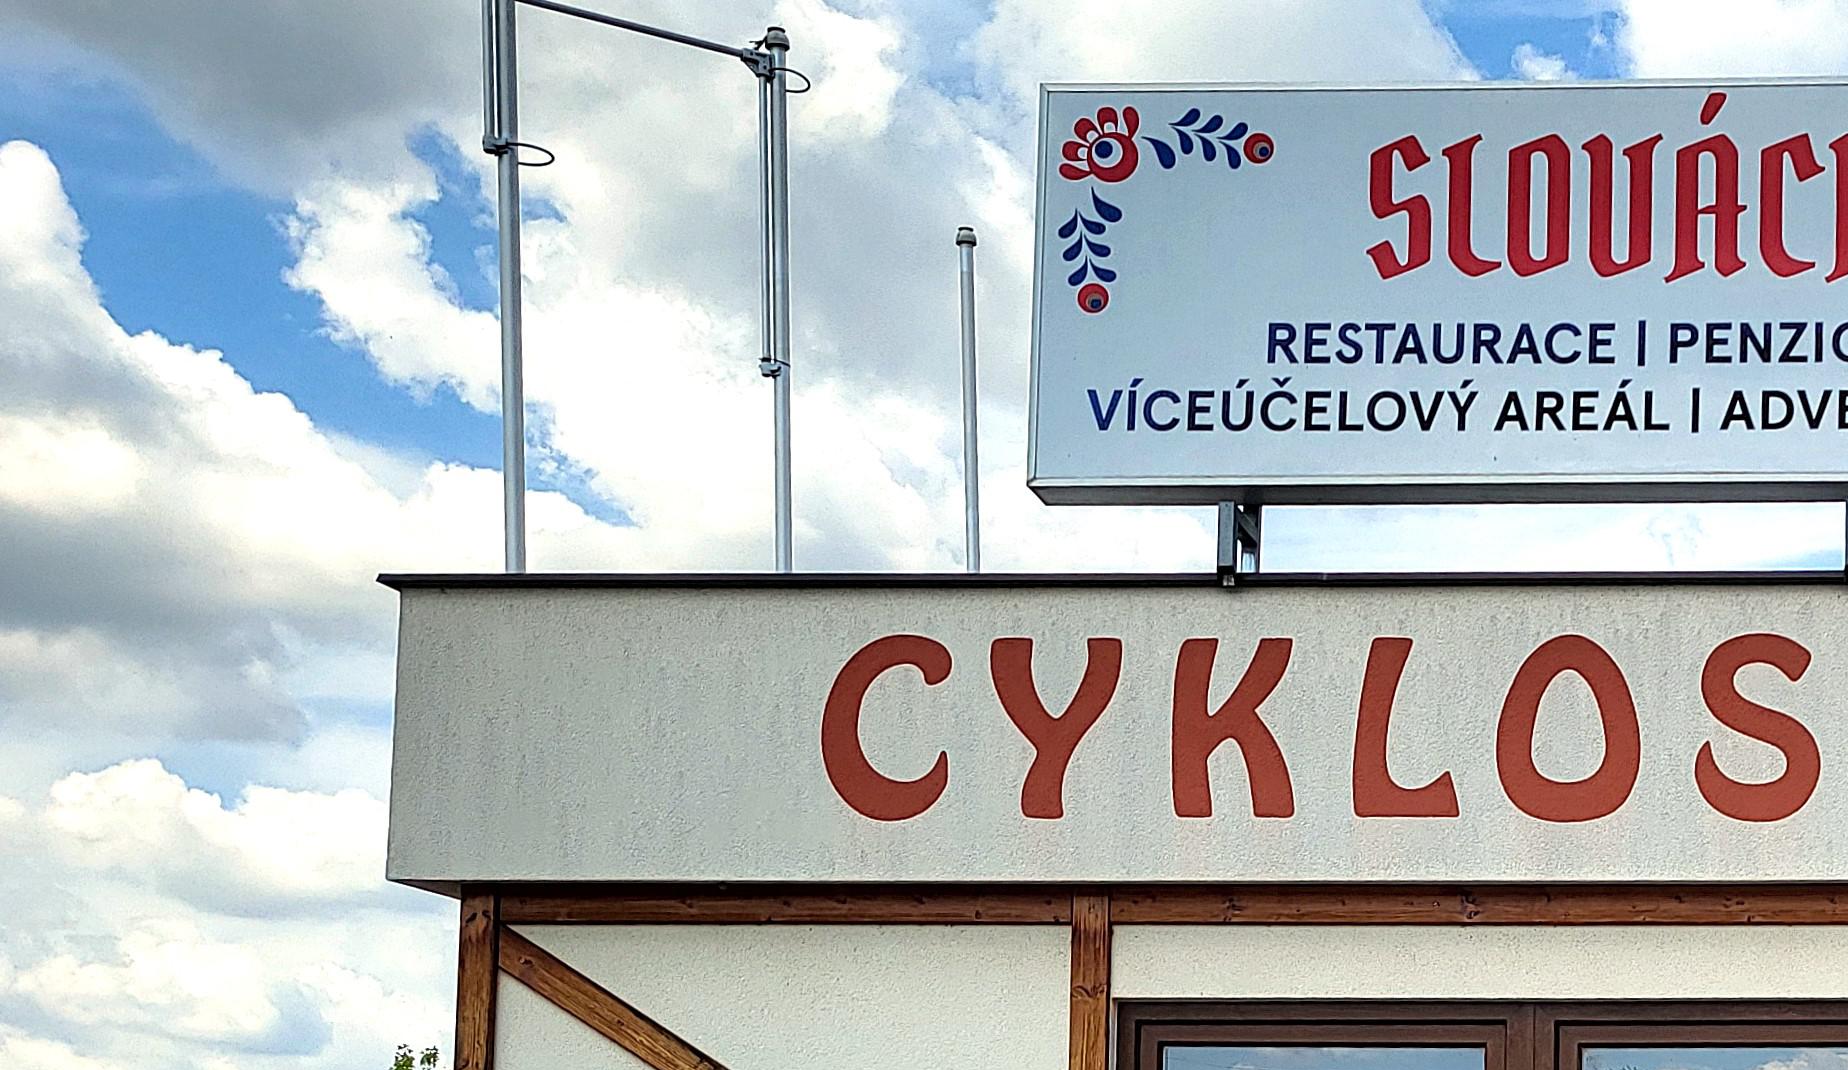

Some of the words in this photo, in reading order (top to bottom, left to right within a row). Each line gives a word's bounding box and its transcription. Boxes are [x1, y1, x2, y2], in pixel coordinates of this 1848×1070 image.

[1267, 322, 1616, 365] RESTAURACE
[1086, 376, 1479, 432] VÍCEÚČELOVÝ
[1493, 378, 1670, 432] AREÁL
